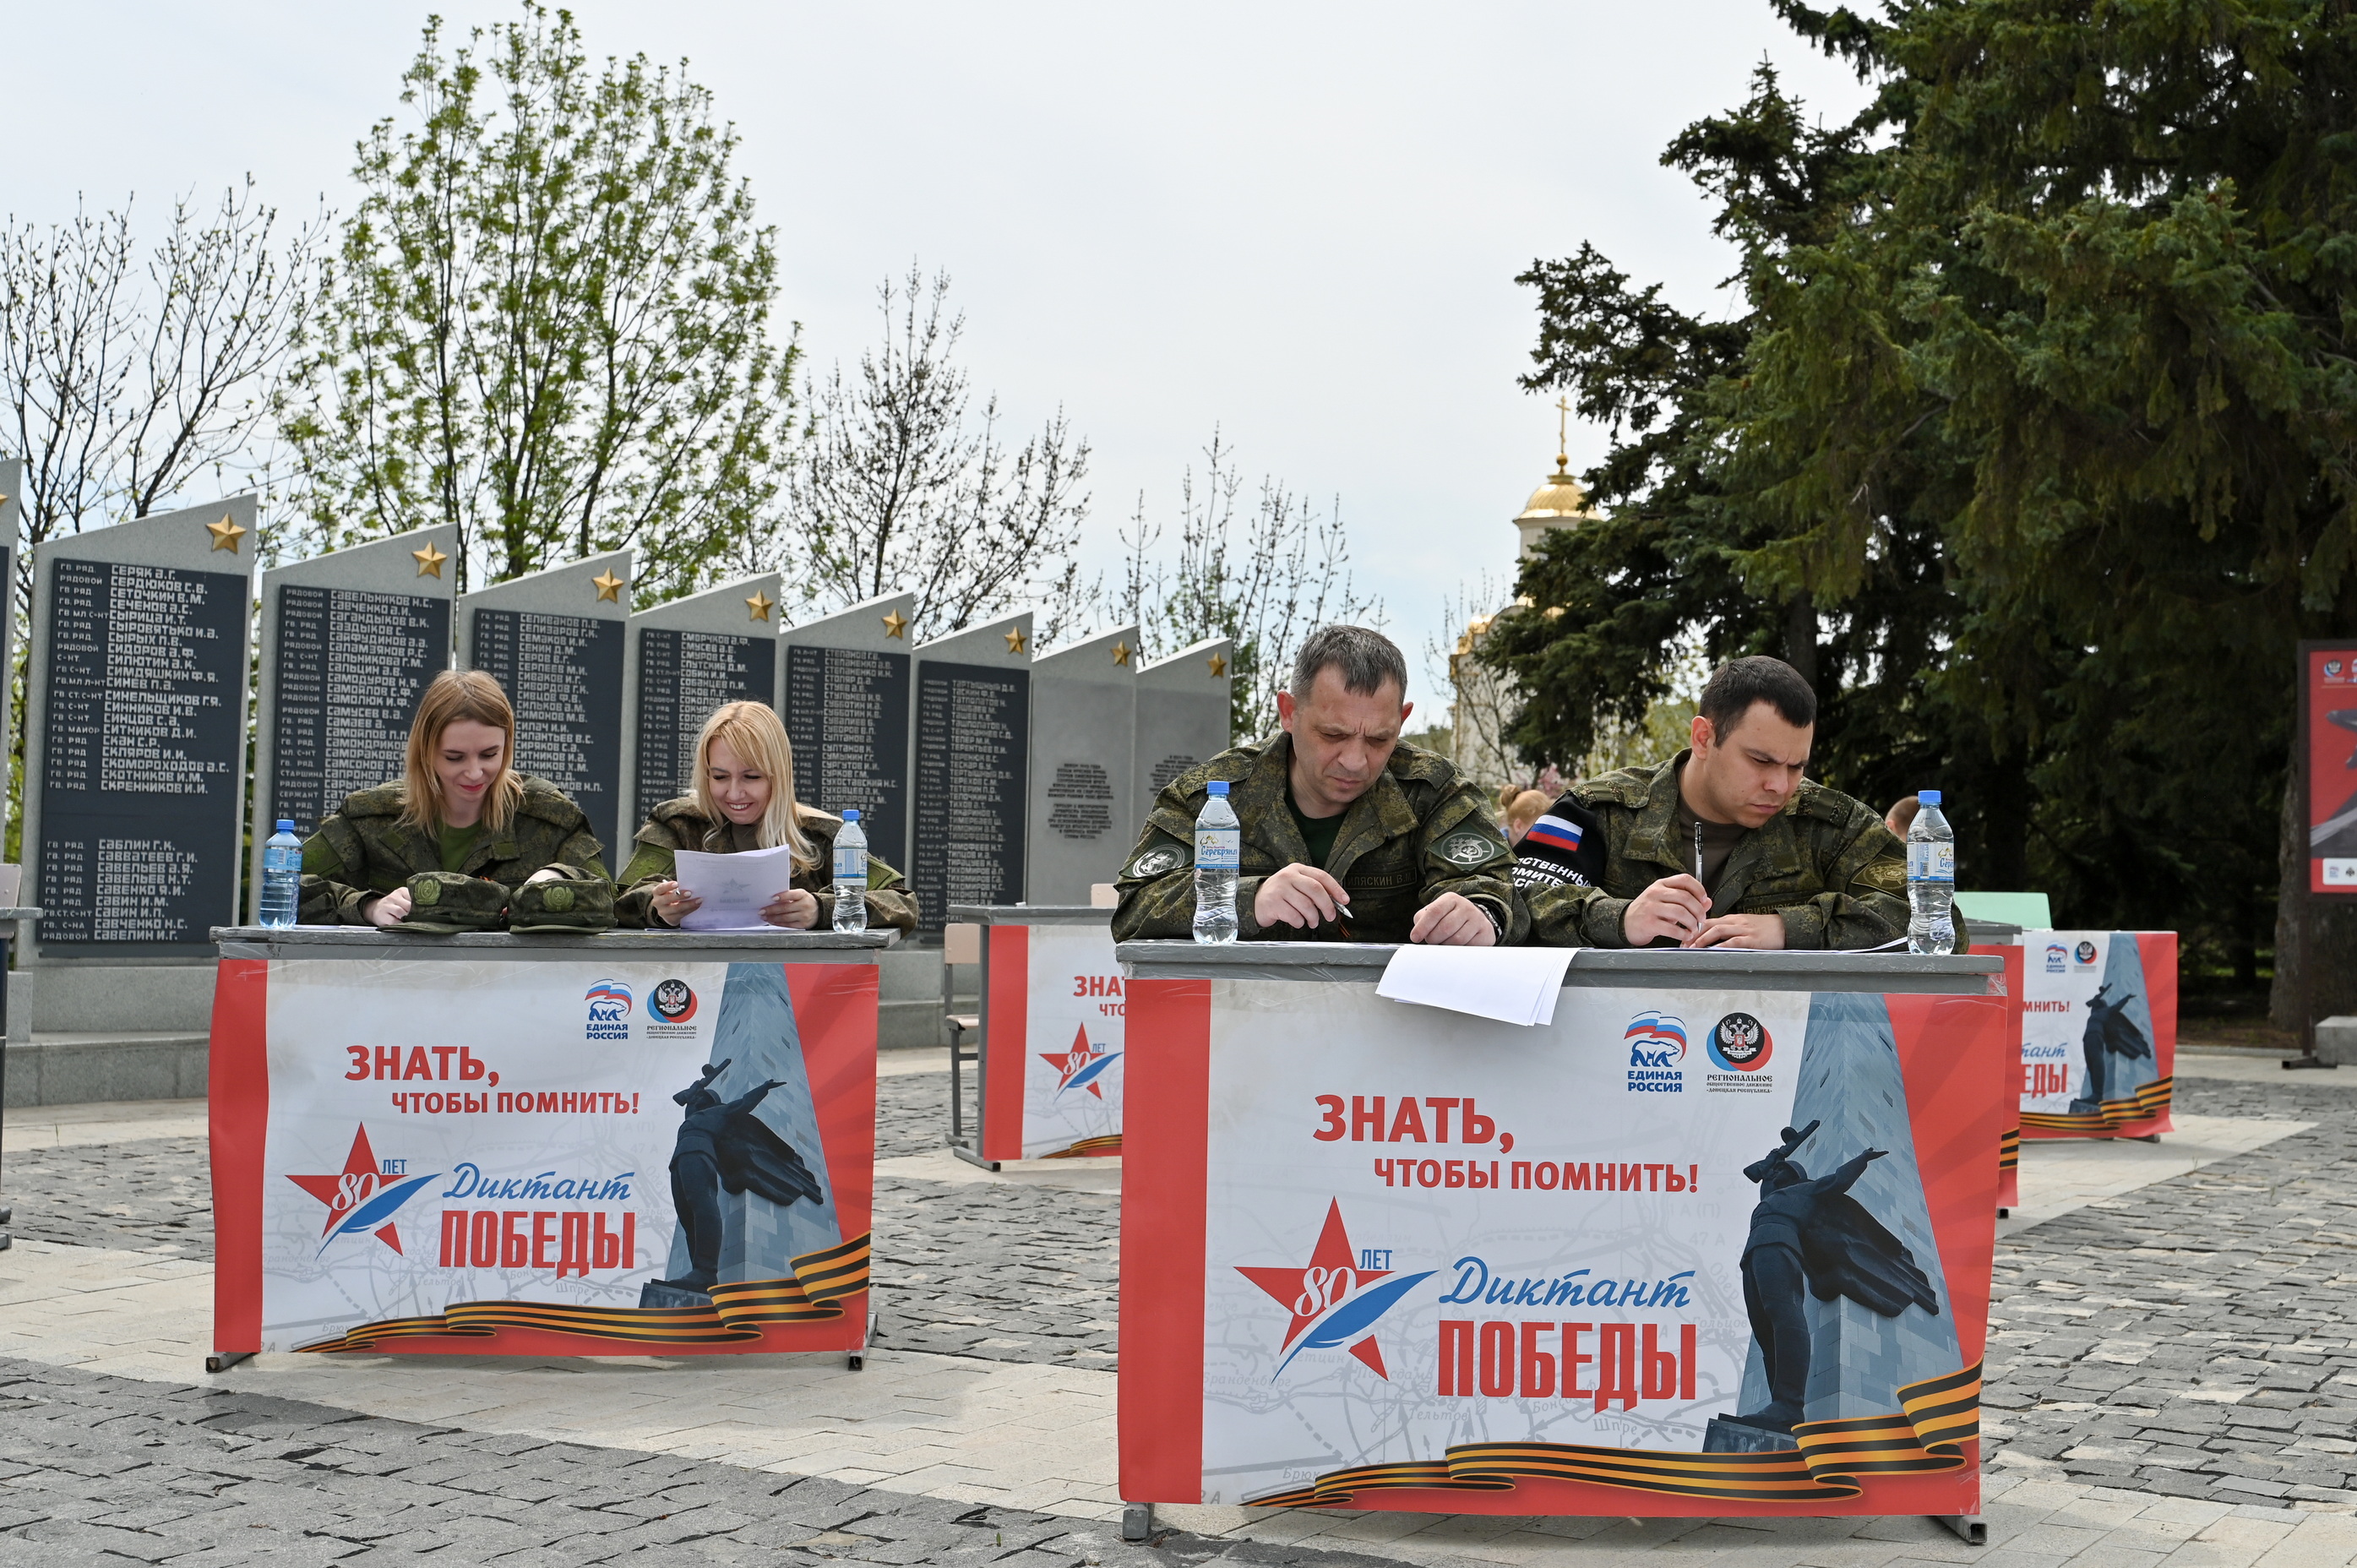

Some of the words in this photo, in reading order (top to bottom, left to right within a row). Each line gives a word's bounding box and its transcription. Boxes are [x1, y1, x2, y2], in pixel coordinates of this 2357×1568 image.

[112, 564, 152, 578] СЕРЯК
[155, 569, 175, 580] А.Г.
[111, 575, 182, 591] СЕРДЮКОВ
[184, 582, 207, 594] С.В.
[110, 586, 175, 602] СЕТОЧКИН
[177, 592, 204, 605] В.М.
[110, 598, 166, 612] СЕЧЕНОВ
[169, 603, 192, 615] А.С.
[109, 609, 162, 623] СЫРИЦА
[165, 613, 186, 625] И.Т.
[109, 620, 193, 636] СЫРОВЯТЬКО
[195, 628, 218, 639] И.А.
[108, 631, 155, 645] СЫРЫХ
[159, 635, 182, 646] П.В.
[57, 643, 98, 651] РЯДОВОЙ
[107, 642, 166, 656] СИДОРОВ
[169, 647, 196, 659] А.Ф.
[107, 654, 168, 668] СИЛЮТИН
[171, 658, 195, 670] А.К.
[106, 666, 188, 680] СИМДЯШКИН
[191, 671, 218, 683] Ф.Я.
[106, 677, 147, 689] СИНЕВ
[150, 679, 175, 690] П.А.
[105, 689, 199, 705] СИНЕЛЬЩИКОВ
[202, 695, 220, 706] Г.Я.
[104, 701, 170, 715] СИННИКОВ
[172, 705, 196, 716] И.В.
[104, 712, 153, 725] СИНЦОВ
[156, 716, 180, 727] С.А.
[103, 723, 168, 737] СИТНИКОВ
[171, 727, 196, 738] Д.И.
[103, 735, 134, 746] СКАН
[137, 737, 160, 748] С.Р.
[102, 746, 160, 759] СКЛЯРОВ
[162, 749, 187, 760] И.И.
[101, 758, 204, 772] СКОМОРОХОДОВ
[206, 762, 229, 772] А.С.
[101, 769, 174, 781] СКОТНИКОВ
[177, 772, 203, 782] И.М.
[101, 780, 182, 793] СКРЕННИКОВ
[184, 783, 208, 793] И.И.
[98, 839, 150, 850] САБЛИН
[153, 840, 175, 851] Г.К.
[98, 851, 173, 862] САВВАТЕЕВ
[176, 852, 198, 863] Г.И.
[97, 862, 165, 873] САВЕЛЬЕВ
[168, 863, 193, 874] А.Я.
[97, 873, 165, 884] САВЕЛЬЕВ
[168, 874, 190, 885] Н.Т.
[96, 885, 155, 895] САВЕНКО
[159, 885, 184, 896] Я.И.
[95, 896, 138, 906] САВИН
[141, 896, 168, 906] И.М.
[95, 906, 137, 917] САВИН
[140, 907, 164, 917] И.П.
[95, 918, 161, 928] САВЧЕНКО
[164, 919, 187, 928] Н.С.
[94, 929, 153, 940] САВЕЛИН
[156, 930, 177, 940] И.Г.
[1092, 1043, 1106, 1053] ЛЕТ
[346, 1046, 498, 1086] ЗНАТЬ,
[1064, 1051, 1091, 1075] 80
[1628, 1070, 1683, 1081] ЕДИНАЯ
[1628, 1082, 1683, 1092] РОССИЯ
[394, 1093, 487, 1113] ЧТОБЫ
[498, 1092, 639, 1113] ПОМНИТЬ!
[1315, 1095, 1514, 1153] ЗНАТЬ,
[382, 1159, 407, 1174] ЛЕТ
[443, 1162, 635, 1200] Диктант
[1375, 1159, 1499, 1188] ЧТОБЫ
[1512, 1162, 1698, 1192] ПОМНИТЬ!
[331, 1173, 380, 1211] 80
[441, 1211, 635, 1278] ПОБЕДЫ
[1360, 1250, 1392, 1270] ЛЕТ
[1440, 1256, 1696, 1309] Диктант
[1294, 1266, 1357, 1316] 80
[1439, 1320, 1696, 1413] ПОБЕДЫ
